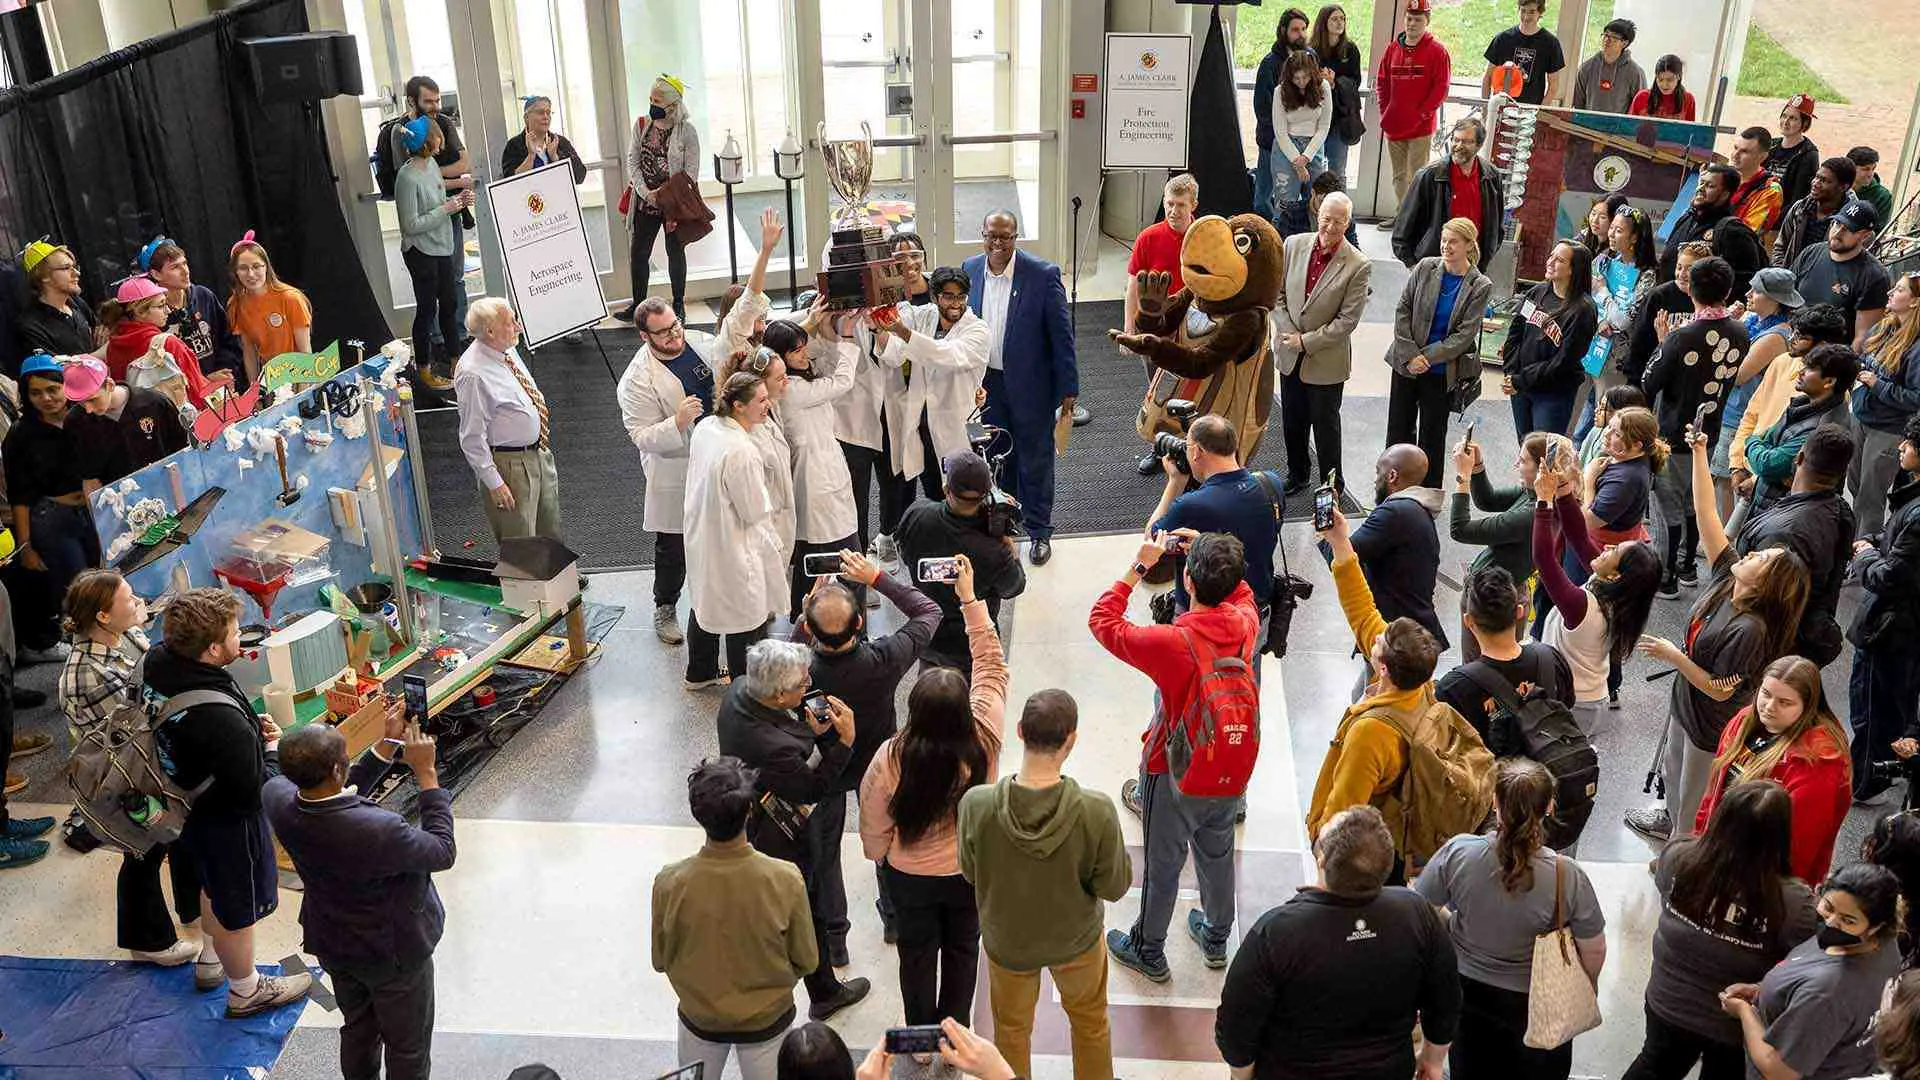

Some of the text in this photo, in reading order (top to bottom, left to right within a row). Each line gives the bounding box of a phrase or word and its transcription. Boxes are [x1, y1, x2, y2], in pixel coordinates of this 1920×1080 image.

[1137, 107, 1156, 117] Fire
[1123, 119, 1170, 128] Protection
[1119, 129, 1174, 142] Engineering
[530, 259, 574, 281] Aerospace
[528, 271, 584, 297] Engineering
[1228, 732, 1243, 745] 22
